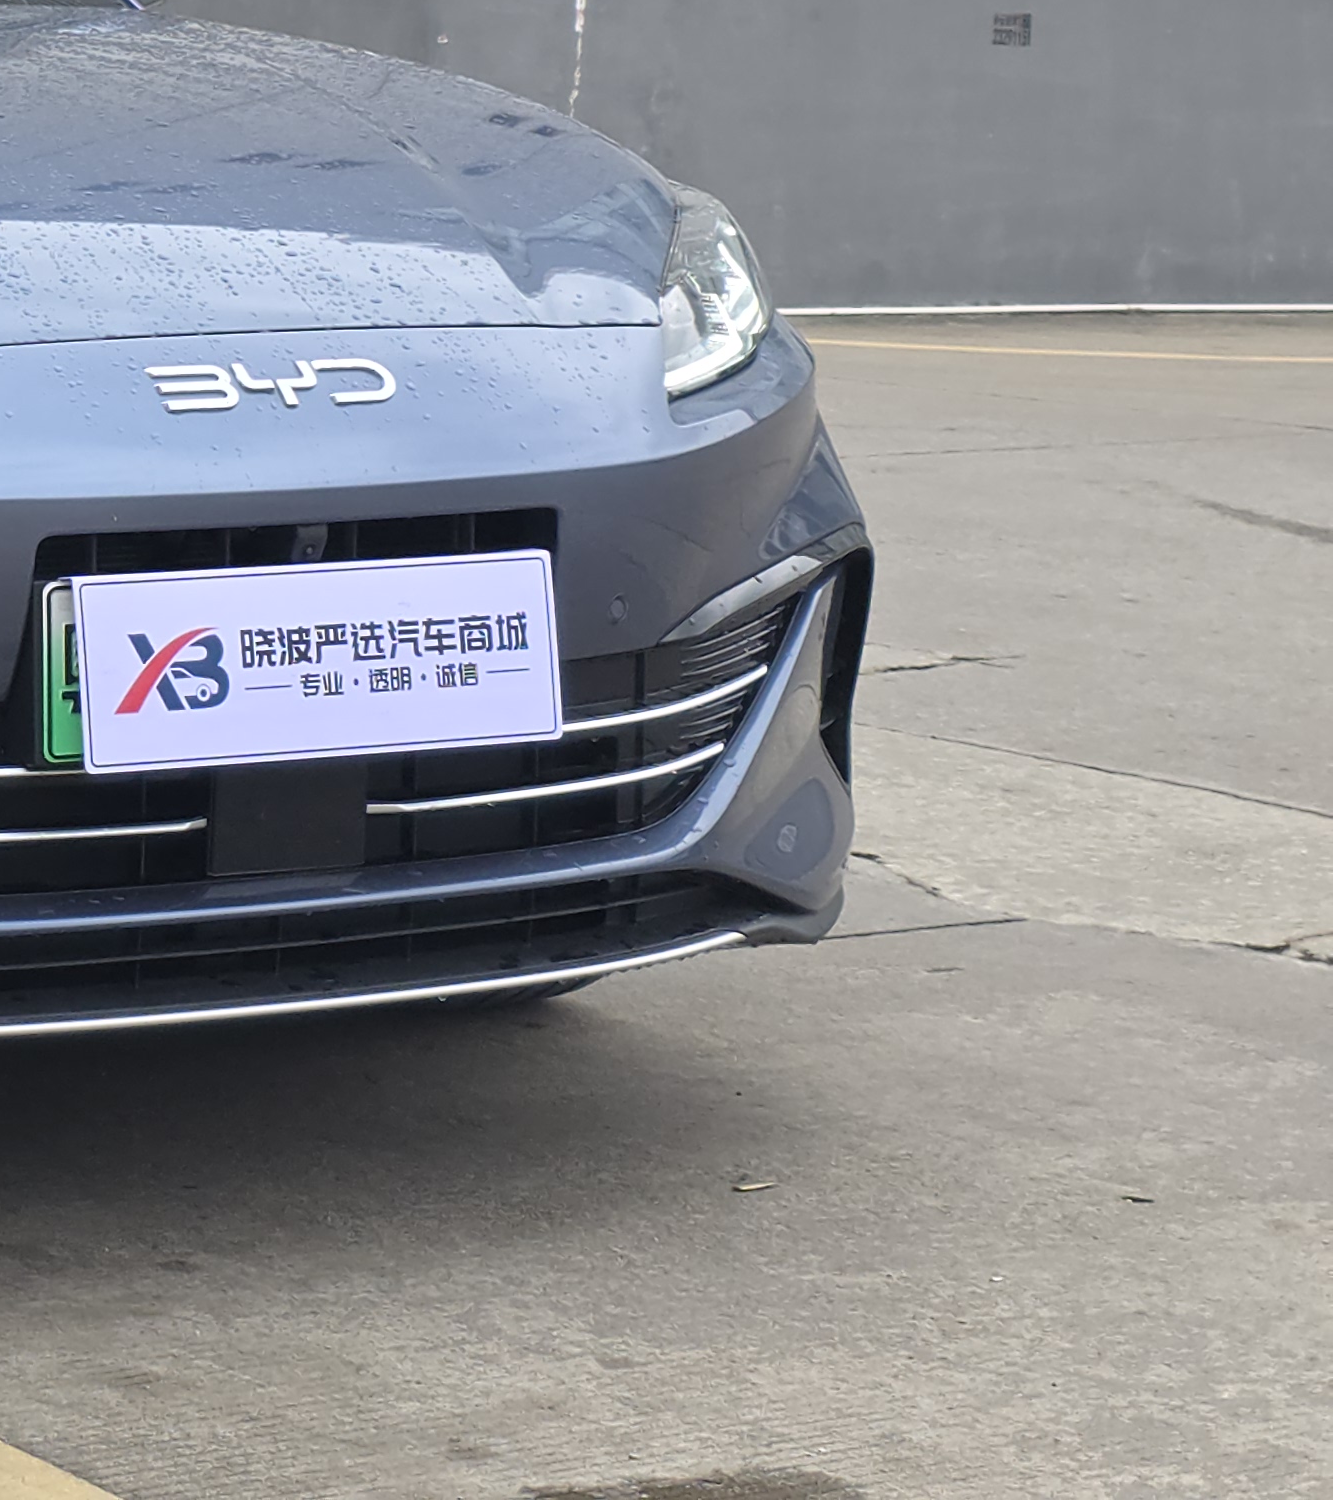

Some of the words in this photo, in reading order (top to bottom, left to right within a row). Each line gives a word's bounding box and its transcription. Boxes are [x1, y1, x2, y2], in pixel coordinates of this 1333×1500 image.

[143, 357, 397, 414] BYD
[240, 612, 529, 668] 晓波严选汽车商城
